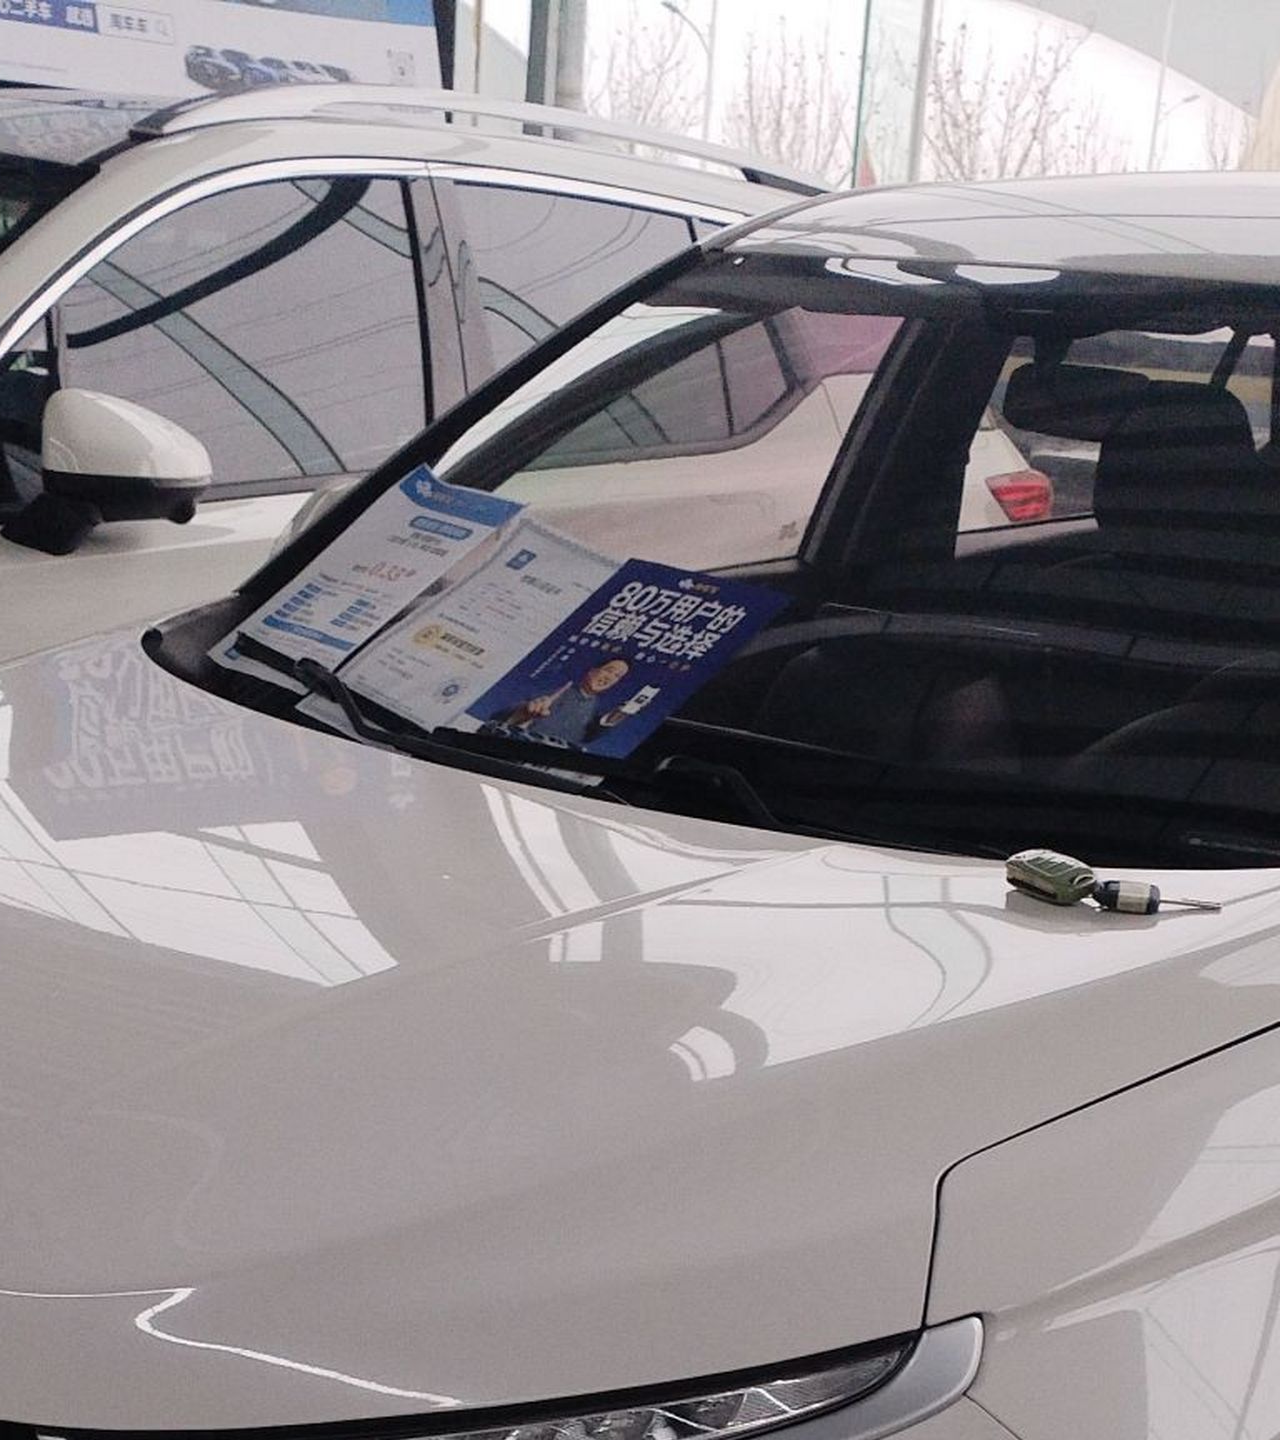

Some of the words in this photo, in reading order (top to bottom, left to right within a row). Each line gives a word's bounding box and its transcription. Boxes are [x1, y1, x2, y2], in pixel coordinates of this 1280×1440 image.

[582, 606, 722, 660] 信赖与选择
[609, 581, 747, 634] 80万用户的
